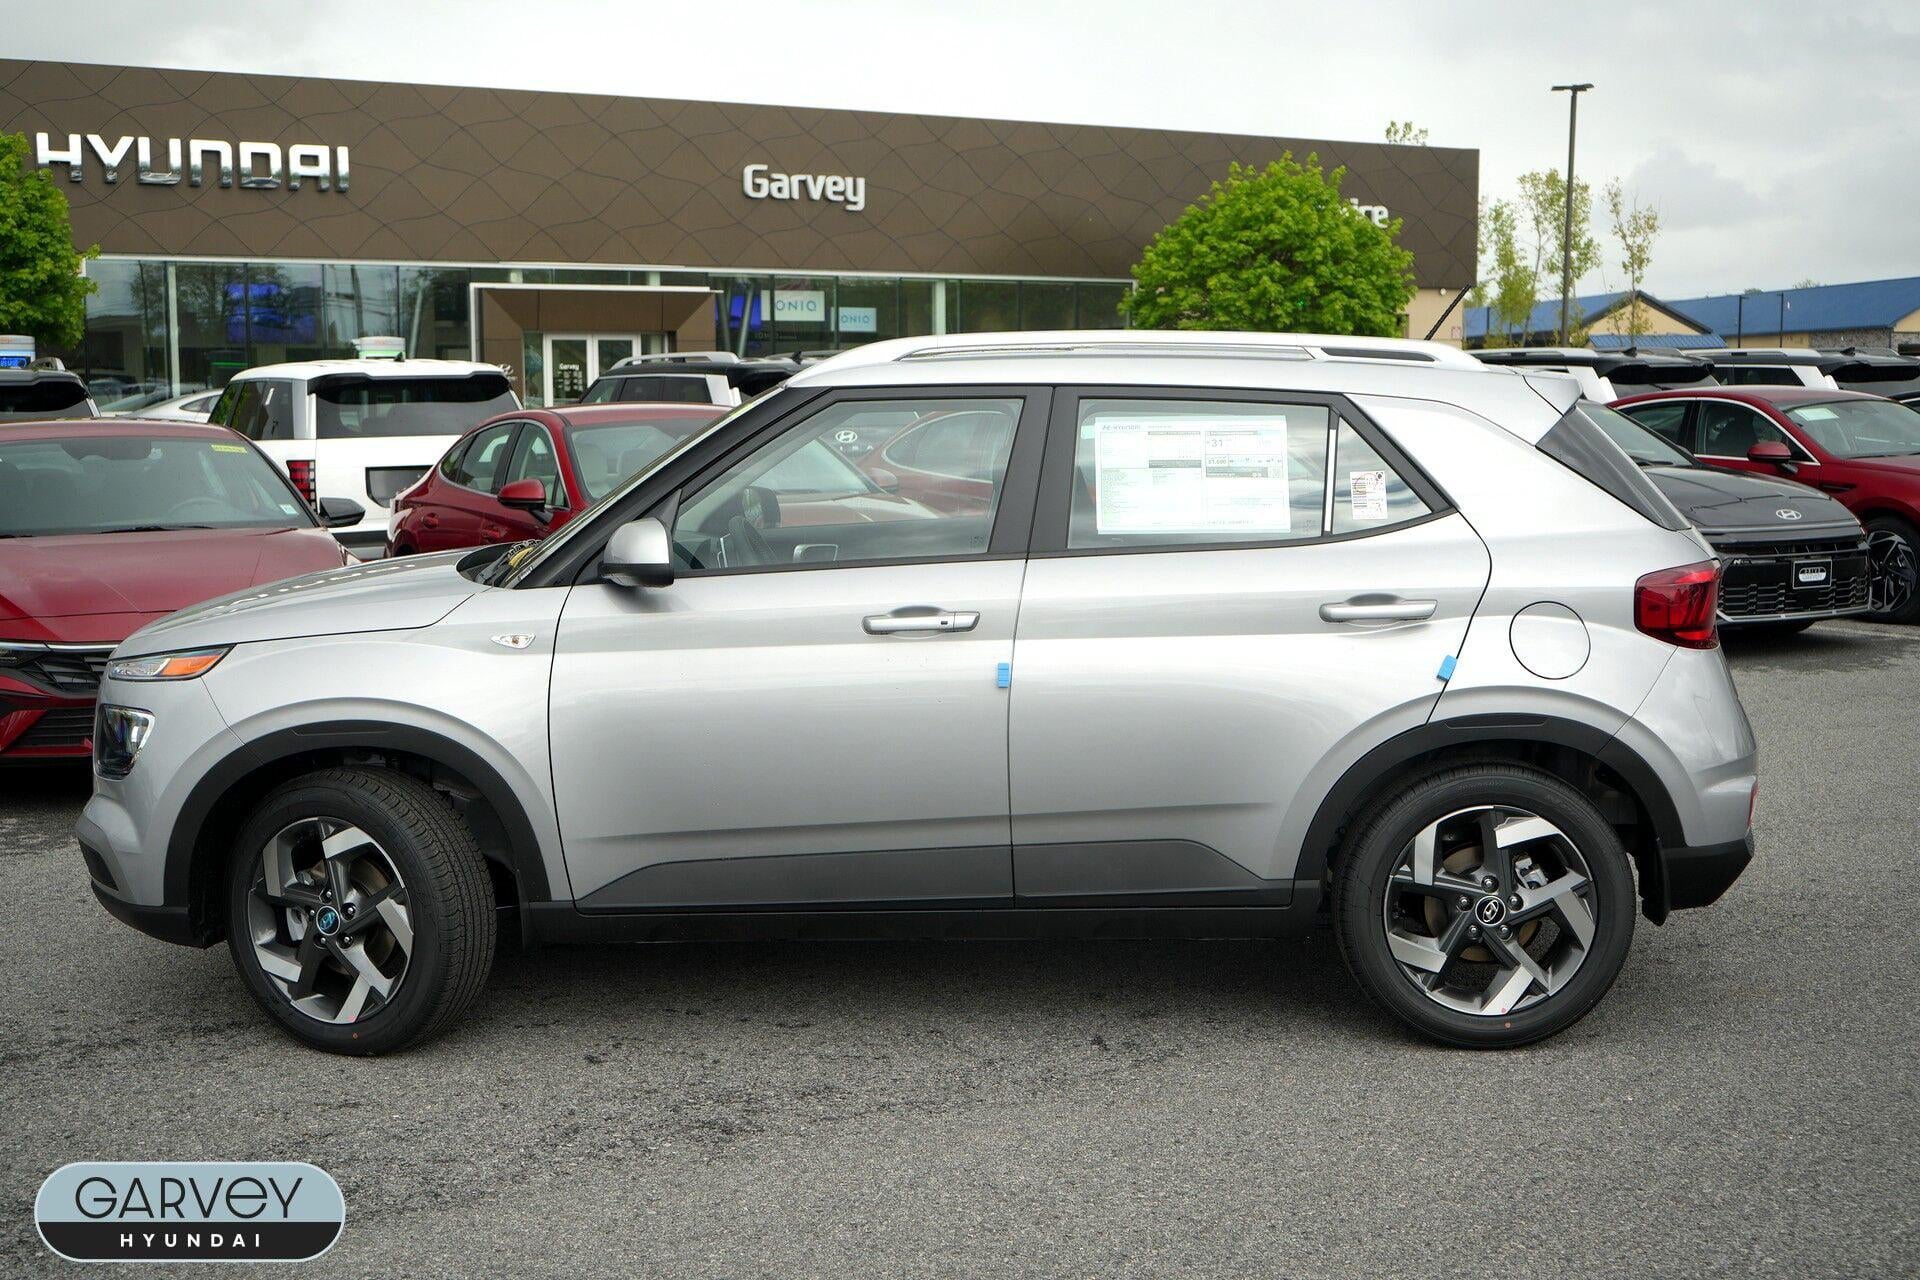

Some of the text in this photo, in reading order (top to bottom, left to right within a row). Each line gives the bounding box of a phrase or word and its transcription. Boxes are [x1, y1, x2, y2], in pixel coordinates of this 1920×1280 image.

[36, 132, 349, 192] HYUNDAI
[743, 163, 866, 211] Garvey
[776, 299, 818, 312] ONIQ
